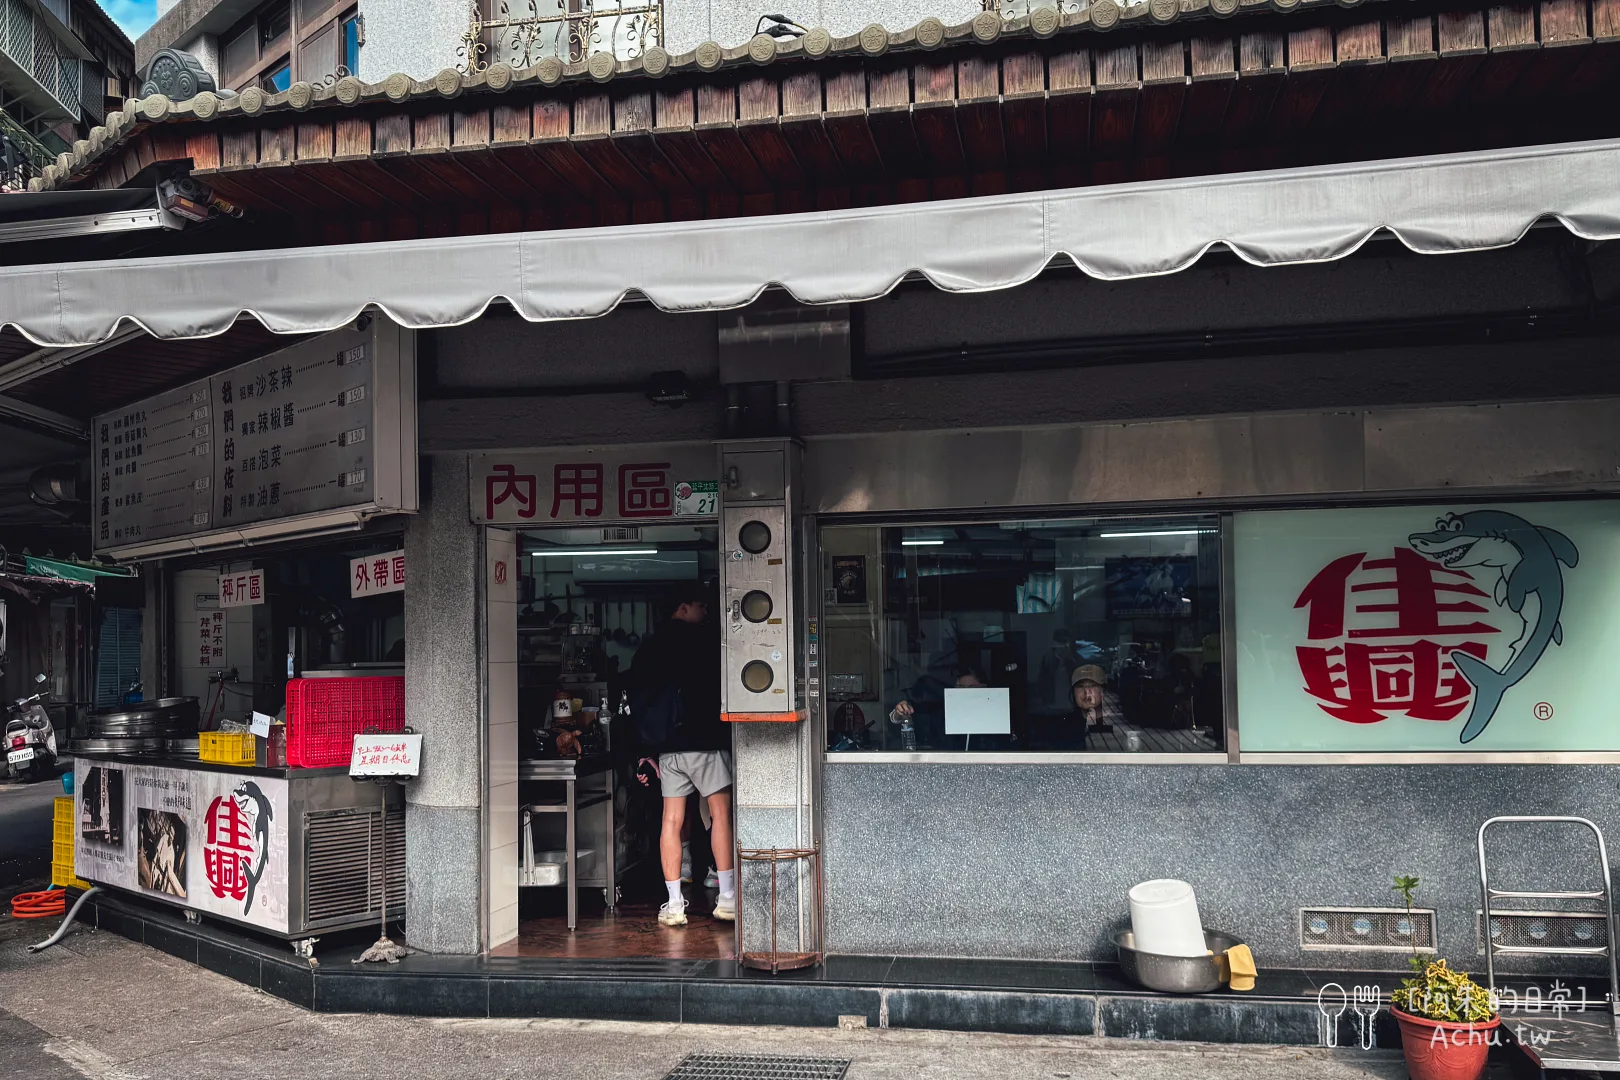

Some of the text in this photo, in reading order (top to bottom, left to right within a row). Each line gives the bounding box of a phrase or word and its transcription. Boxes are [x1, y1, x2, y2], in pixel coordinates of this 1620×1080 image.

[349, 347, 361, 362] 150
[349, 388, 361, 402] 150
[221, 380, 235, 518] 我們的佐料
[350, 429, 362, 443] 130
[350, 471, 362, 484] 170
[485, 462, 673, 520] 內用區
[356, 553, 405, 591] 外帶區
[212, 612, 223, 657] 秤斤不附
